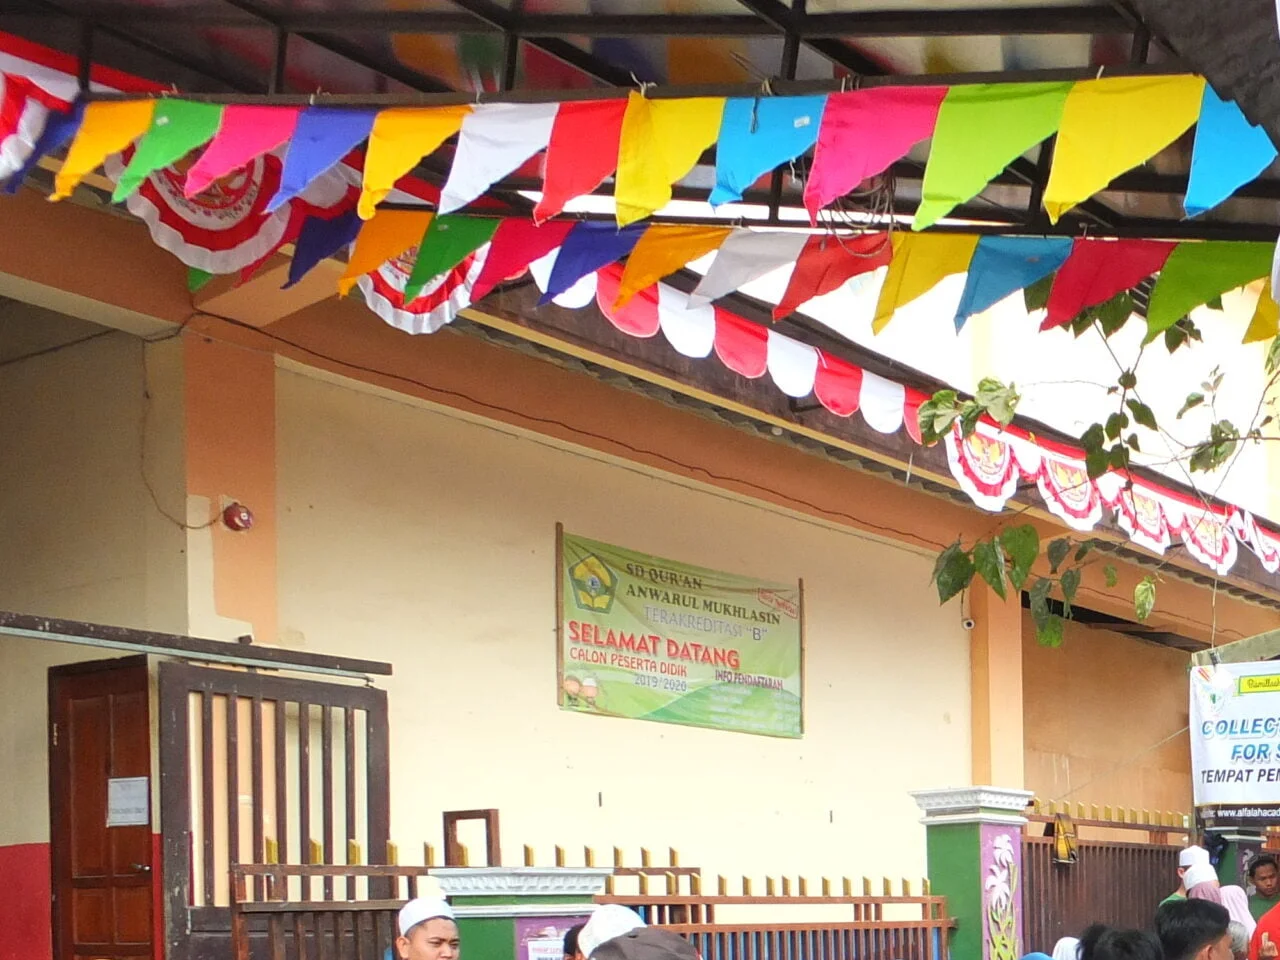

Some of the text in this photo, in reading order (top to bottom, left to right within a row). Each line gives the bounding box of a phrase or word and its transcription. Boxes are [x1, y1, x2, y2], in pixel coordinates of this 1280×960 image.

[626, 584, 700, 610] ANWARUL
[703, 600, 781, 625] MUKHLASIN
[644, 605, 742, 637] TERAKREDITASI
[568, 620, 741, 670] SELAMAT DATANG
[569, 647, 687, 677] CALON PESERTA DIDIK
[715, 669, 783, 690] INFO PENDAFTARAN
[1231, 743, 1270, 760] FOR
[1201, 769, 1253, 783] TEMPAT
